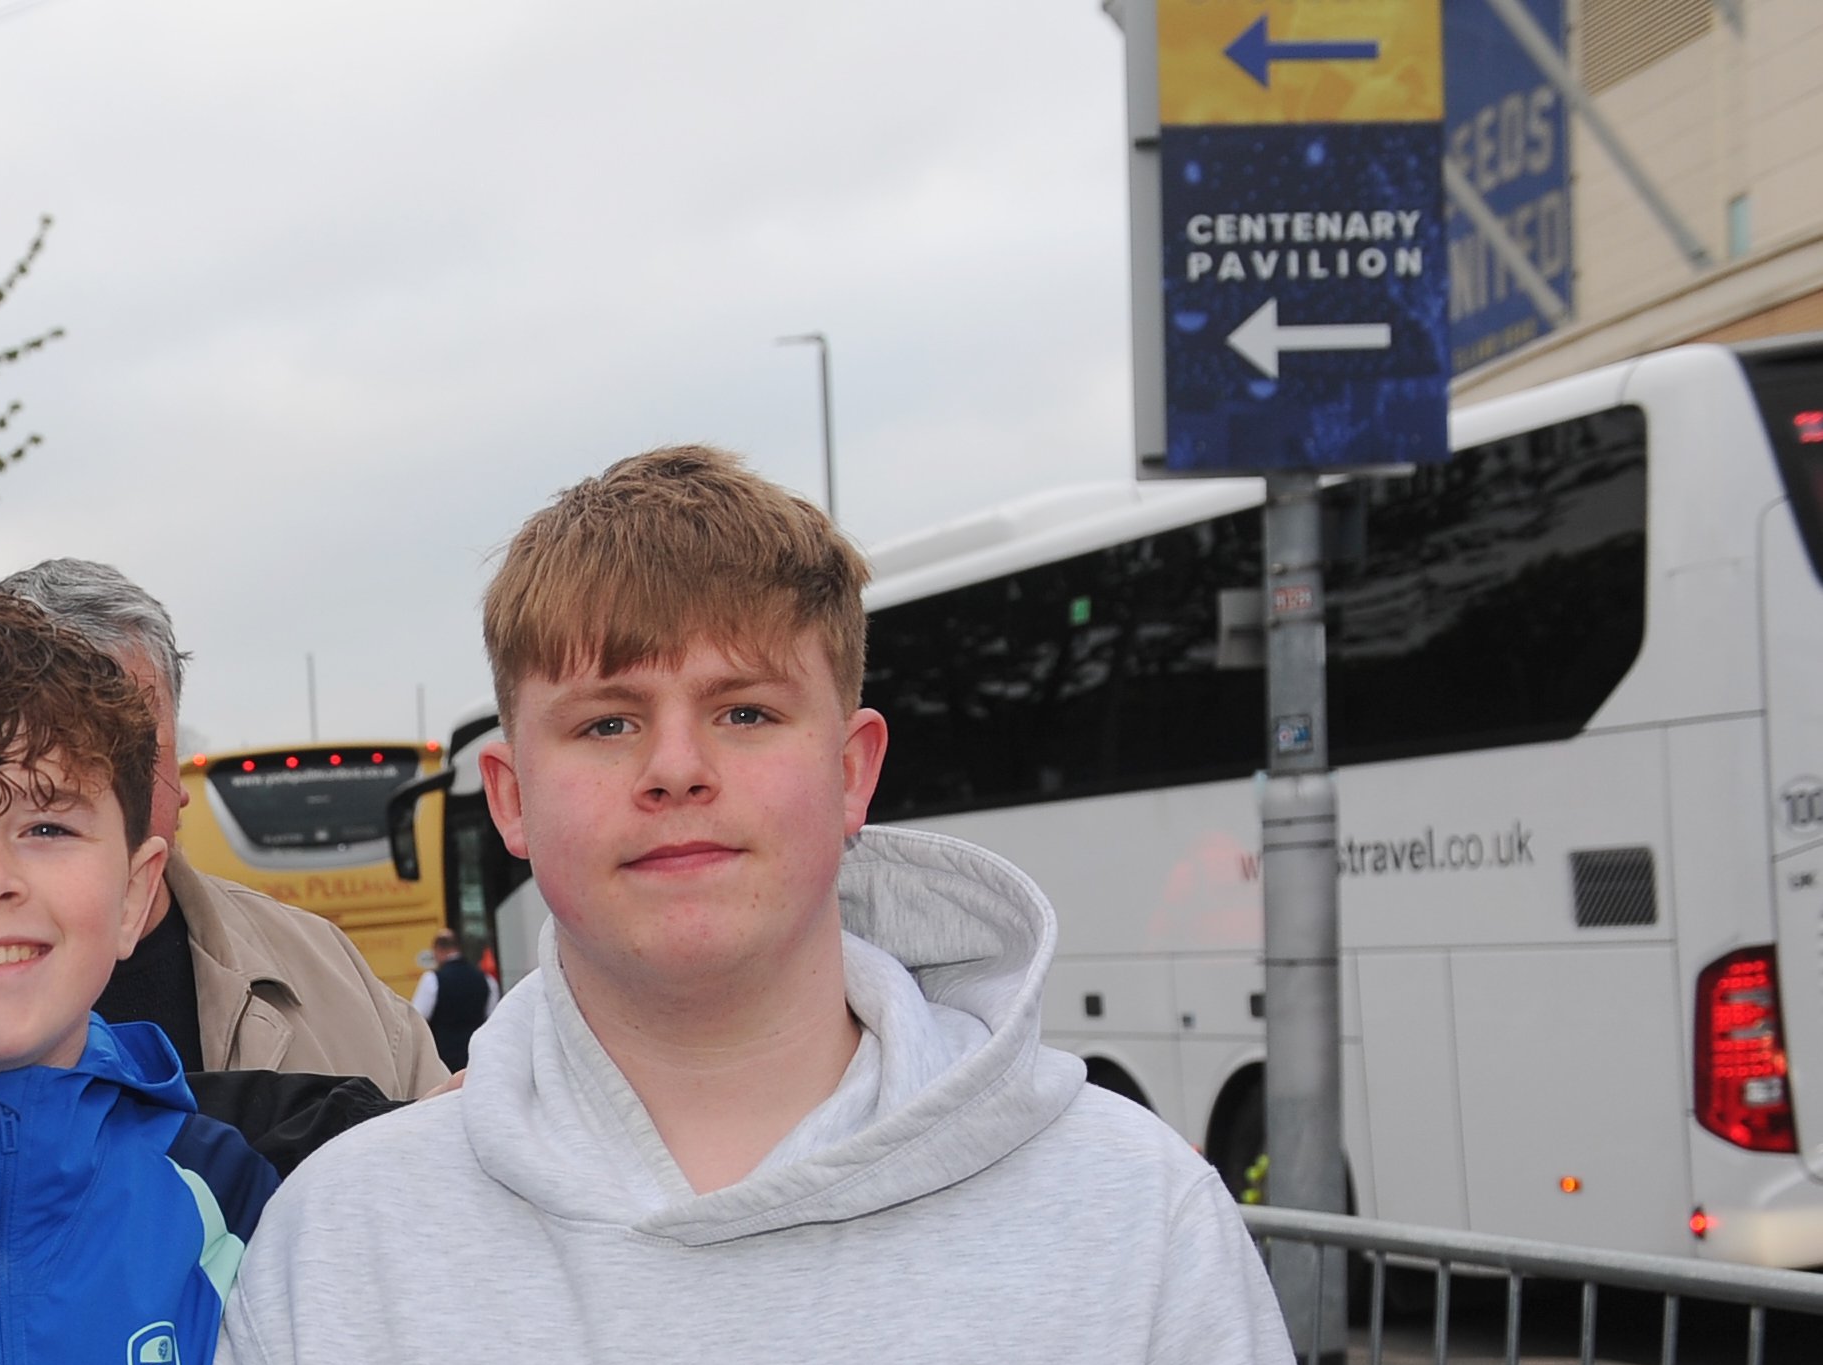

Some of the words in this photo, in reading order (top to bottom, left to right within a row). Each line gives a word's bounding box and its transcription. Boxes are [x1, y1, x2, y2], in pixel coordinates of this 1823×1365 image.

[1449, 85, 1555, 192] EEDS
[1186, 210, 1422, 245] CENTENARY
[1187, 247, 1423, 282] PAVILION
